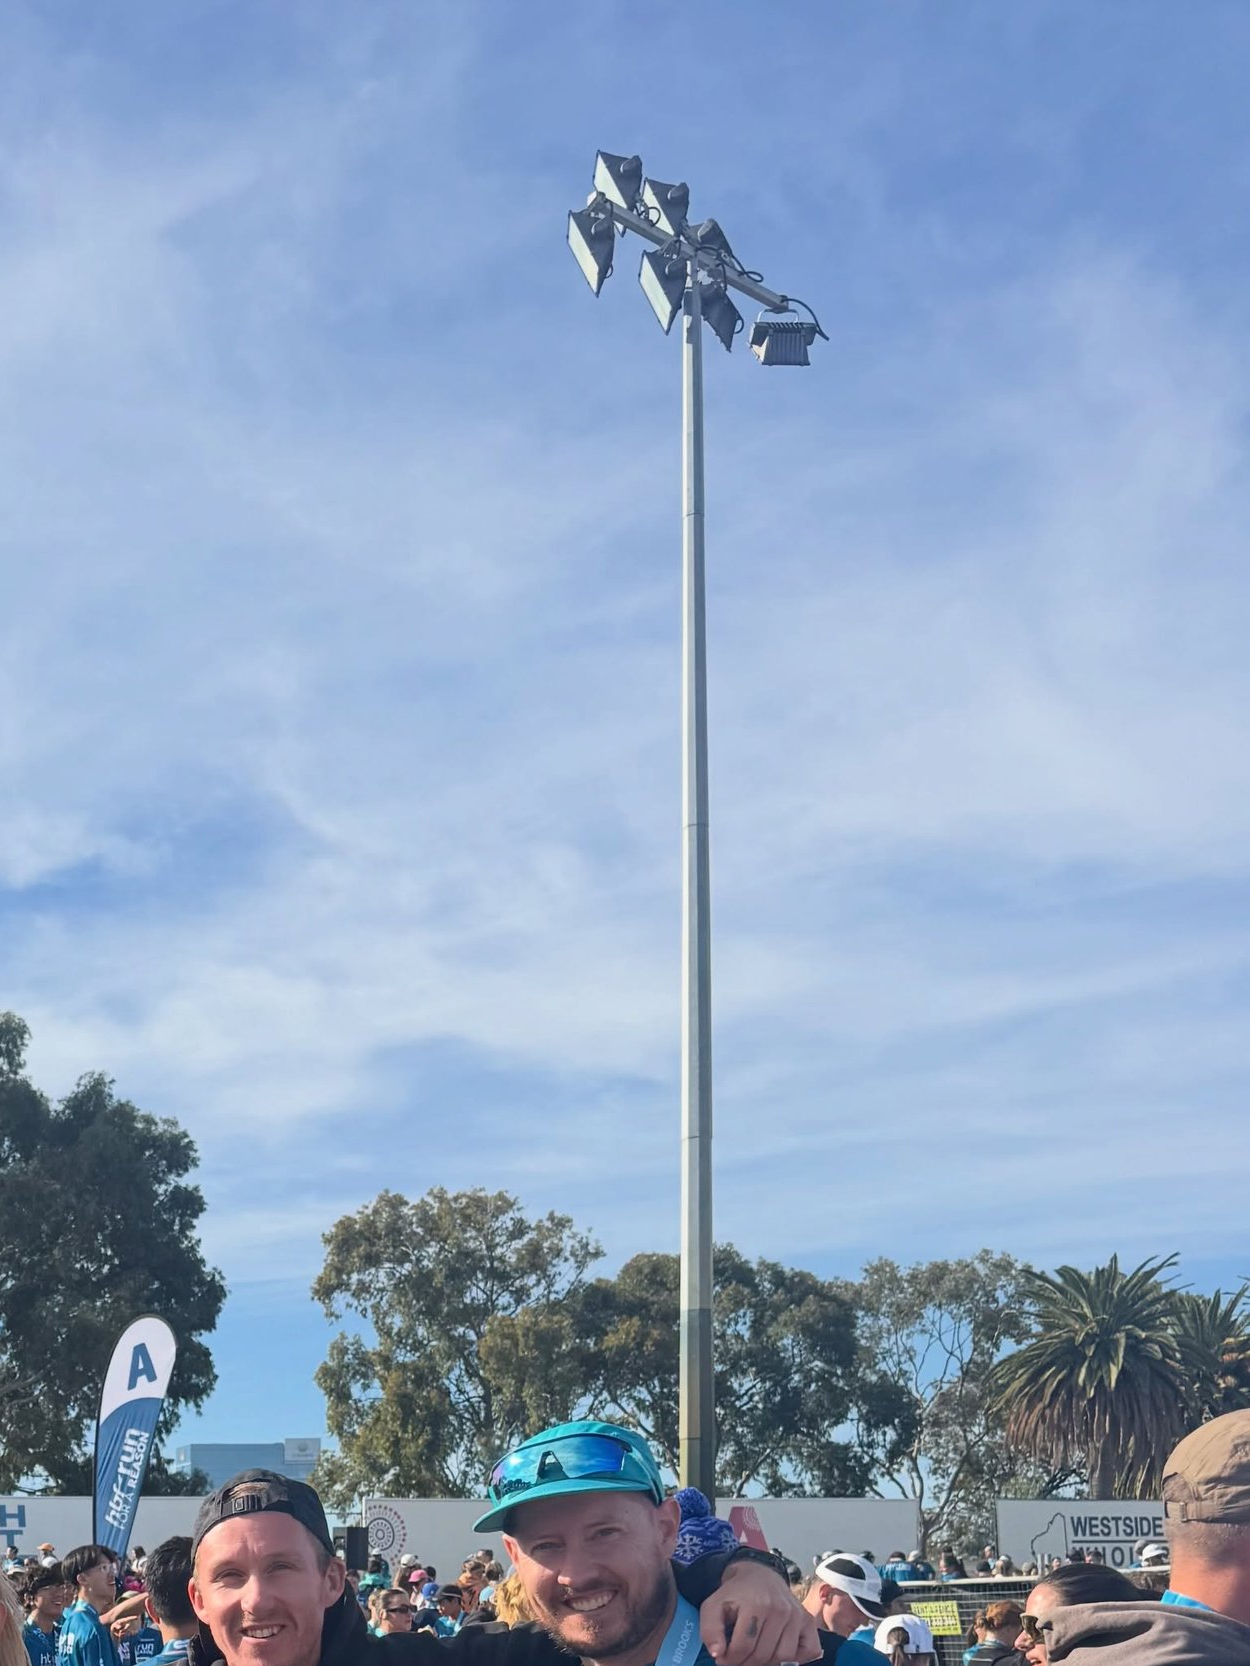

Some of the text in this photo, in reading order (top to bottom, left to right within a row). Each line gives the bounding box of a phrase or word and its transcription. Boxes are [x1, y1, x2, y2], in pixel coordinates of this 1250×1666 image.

[127, 1343, 157, 1391] A
[105, 1428, 141, 1527] hbf run
[117, 1431, 150, 1530] FOR A REASON
[1070, 1516, 1164, 1537] WESTSIDE
[673, 1620, 694, 1664] BROOKS
